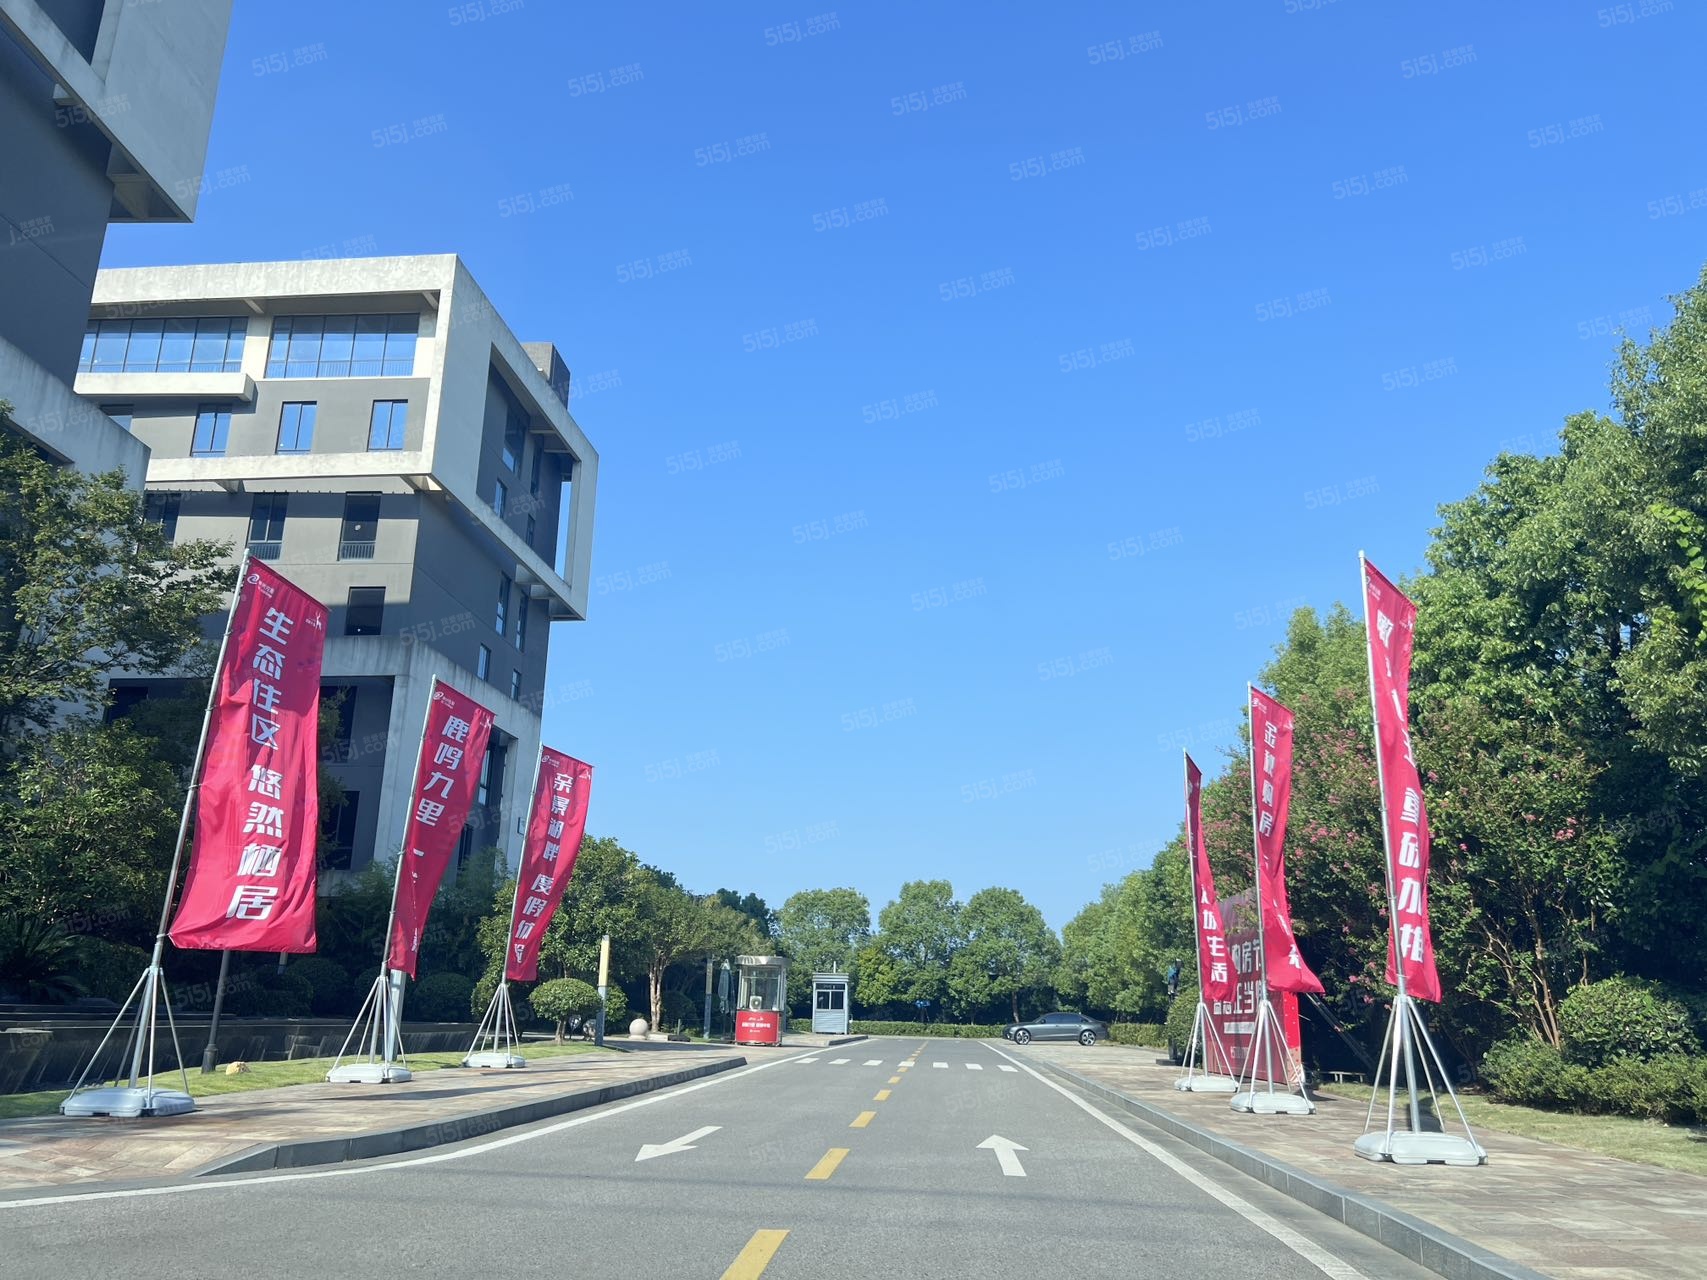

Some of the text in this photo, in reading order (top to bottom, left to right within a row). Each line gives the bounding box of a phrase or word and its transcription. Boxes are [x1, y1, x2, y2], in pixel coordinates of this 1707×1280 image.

[225, 607, 294, 920] 生态住区 悠然栖居
[415, 714, 470, 828] 鹿鸣九里
